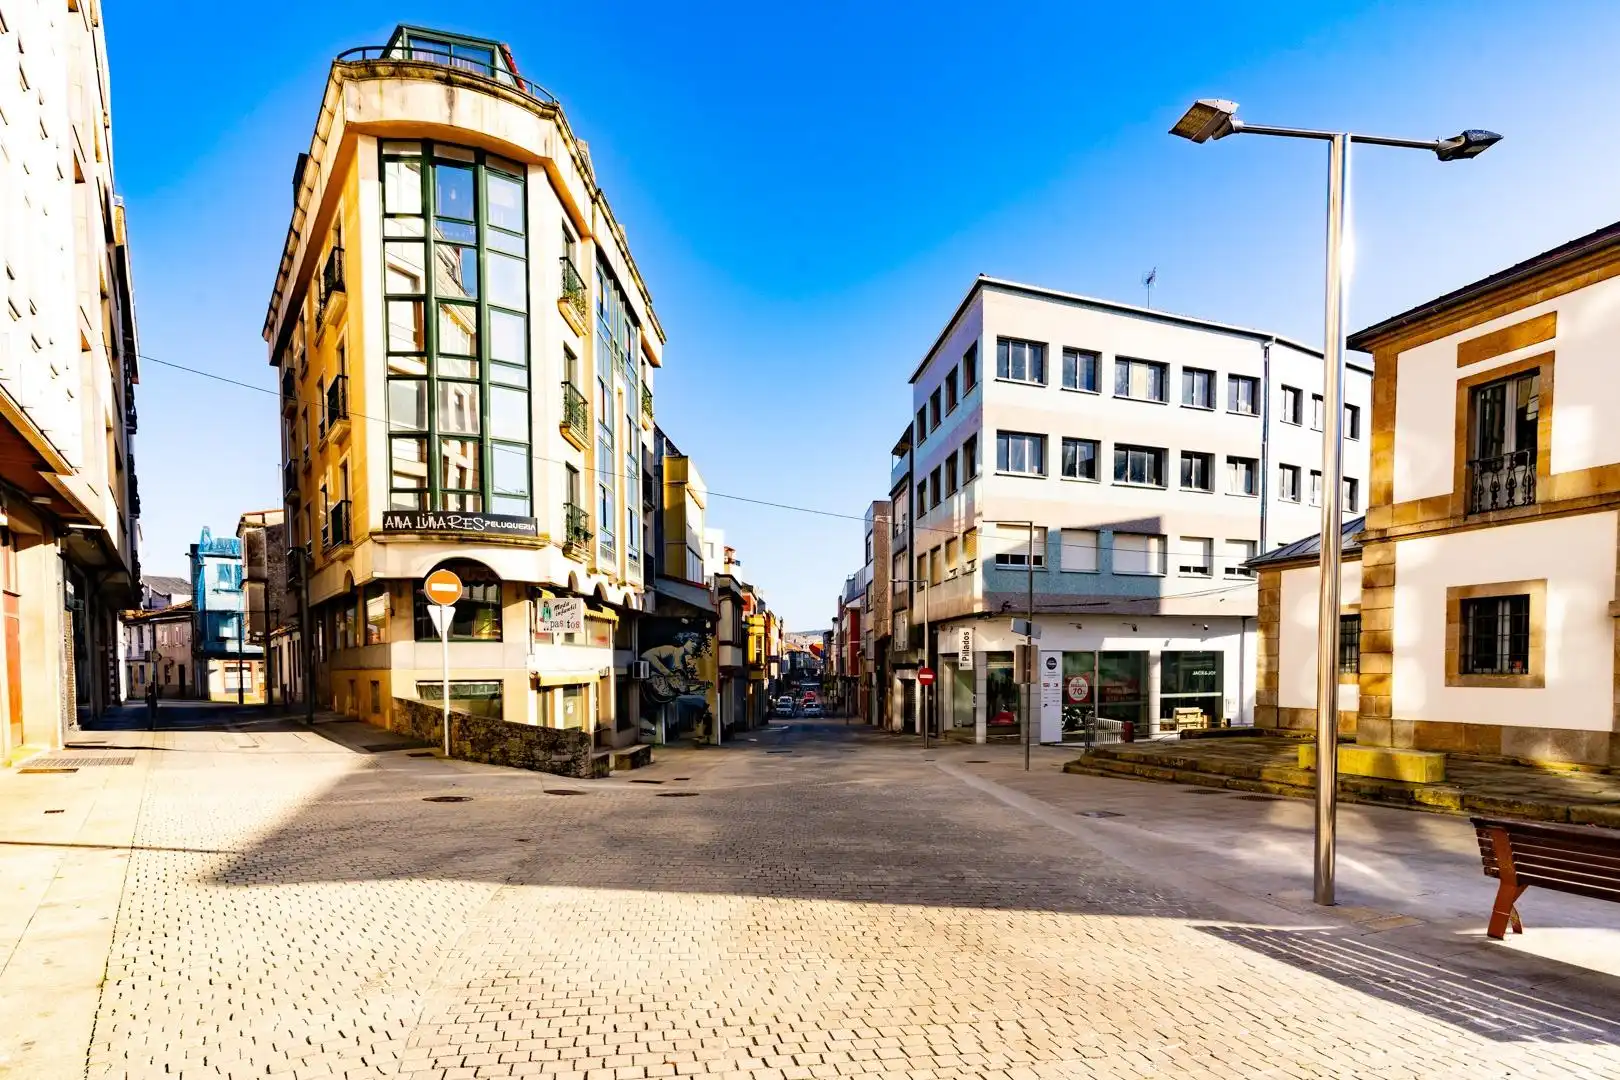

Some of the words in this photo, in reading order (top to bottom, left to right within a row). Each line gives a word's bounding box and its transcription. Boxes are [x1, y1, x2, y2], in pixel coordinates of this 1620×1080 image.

[385, 515, 412, 529] ANA
[485, 520, 536, 530] PELUQUERIA
[962, 631, 970, 661] Pillados
